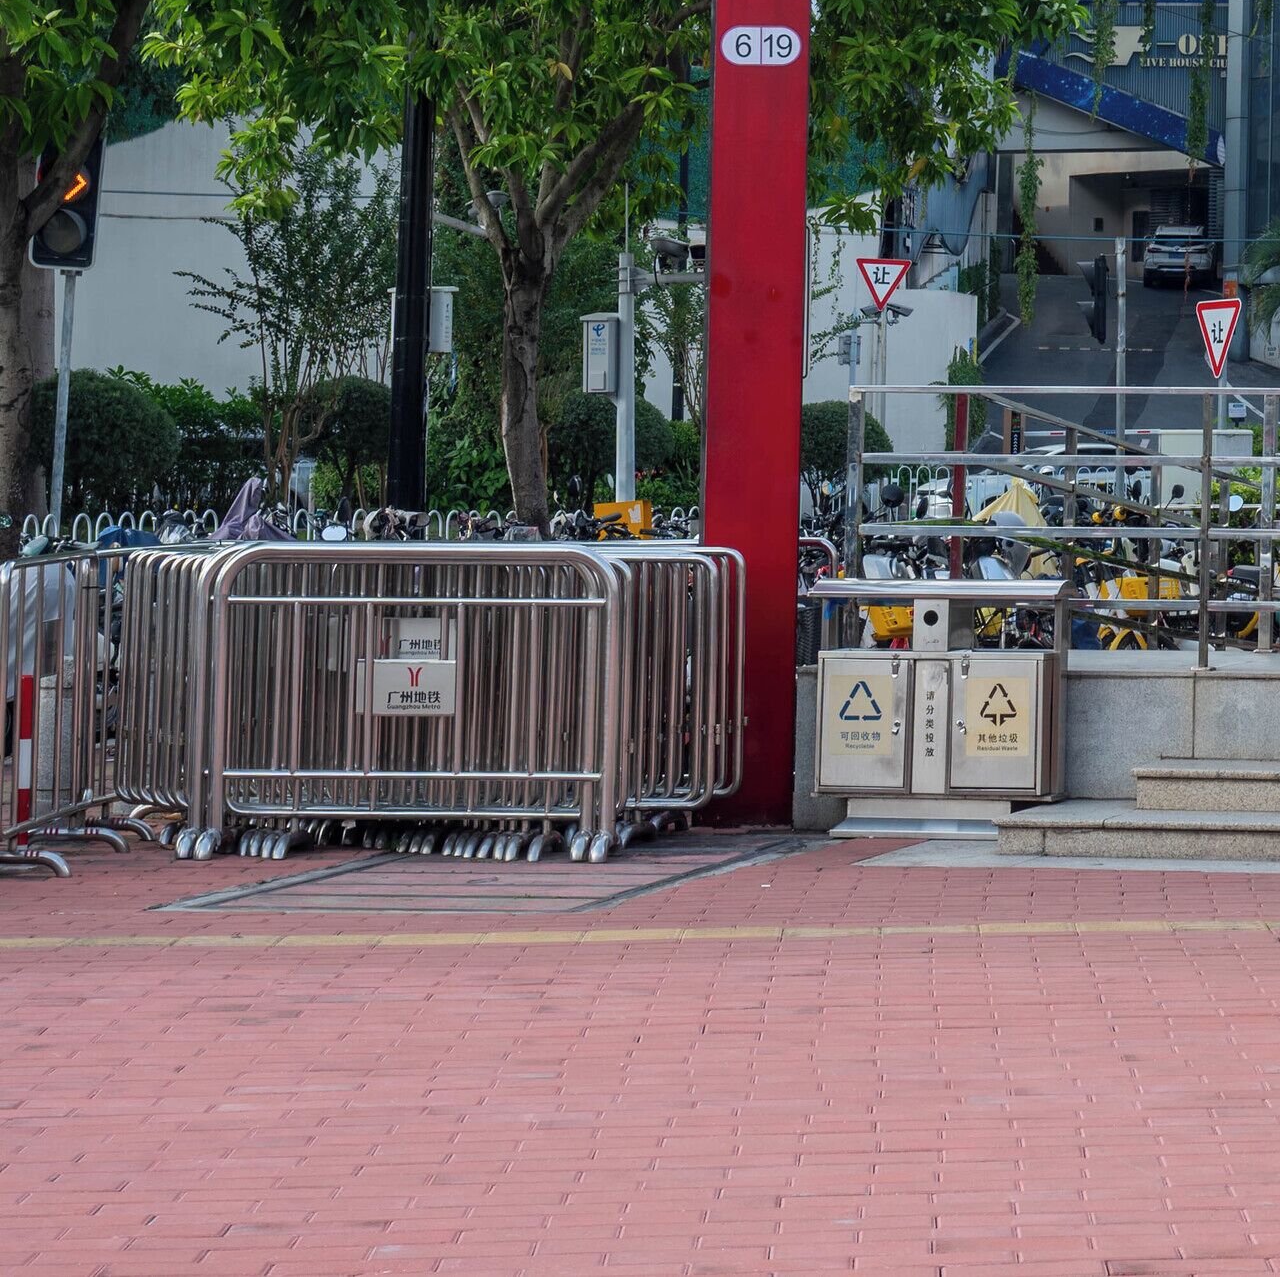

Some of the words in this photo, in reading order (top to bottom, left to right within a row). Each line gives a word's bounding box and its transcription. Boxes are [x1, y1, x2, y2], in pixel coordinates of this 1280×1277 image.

[735, 33, 752, 58] 6
[763, 33, 793, 58] 19
[873, 267, 890, 284] 让
[1211, 321, 1223, 343] 让
[387, 691, 441, 704] 广州地铁
[925, 690, 936, 756] 请分类投放
[840, 731, 881, 742] 可回收物
[977, 733, 1018, 743] 其他垃圾
